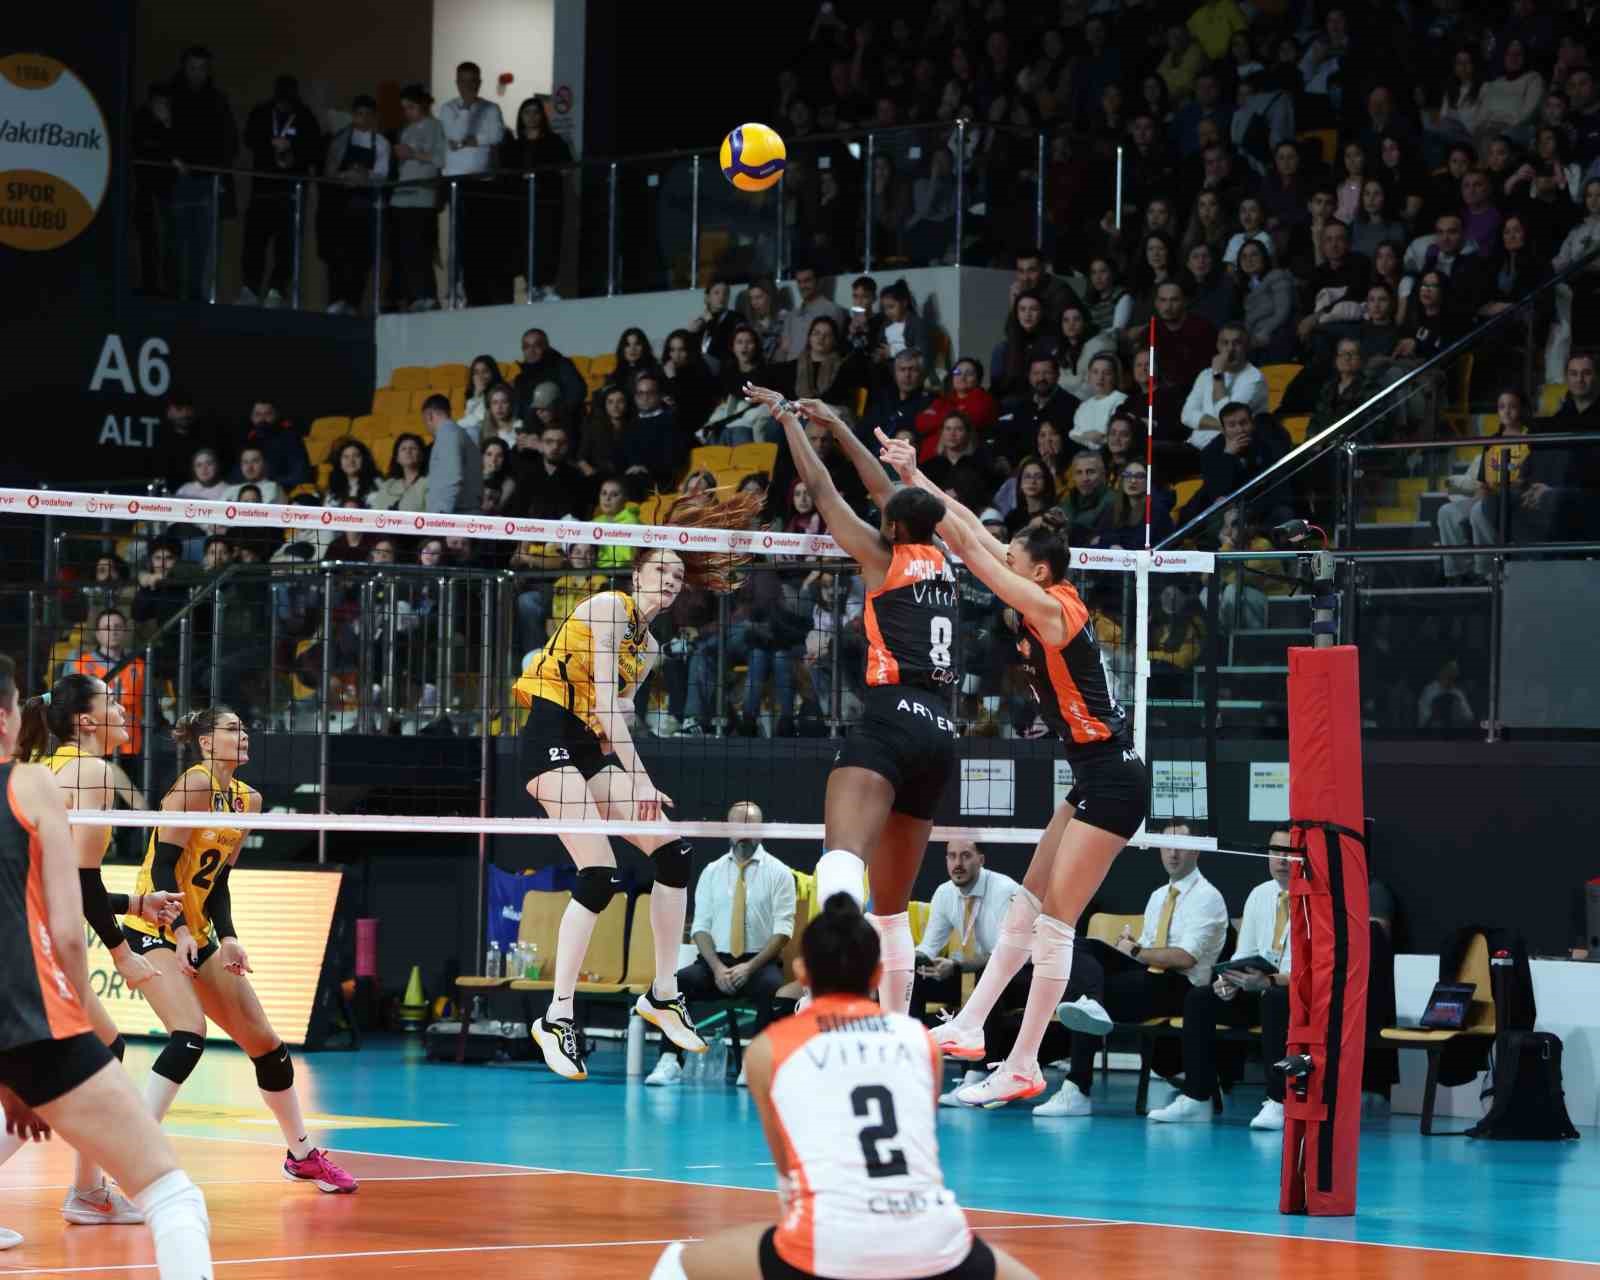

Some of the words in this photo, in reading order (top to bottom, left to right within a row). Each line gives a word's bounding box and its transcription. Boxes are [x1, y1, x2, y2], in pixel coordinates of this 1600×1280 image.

[7, 182, 56, 204] SPOR
[88, 333, 170, 397] A6
[98, 414, 160, 448] ALT
[41, 498, 73, 508] vodafone
[140, 503, 173, 513] vodafone
[239, 509, 269, 518] vodafone
[334, 514, 364, 523] vodafone
[426, 520, 456, 529] vodafone
[516, 525, 545, 533] vodafone
[604, 530, 632, 539] vodafone
[688, 535, 718, 543] vodafone
[773, 539, 801, 548] vodafone
[929, 615, 953, 667] 8
[549, 747, 570, 761] 23
[850, 1084, 910, 1178] 2
